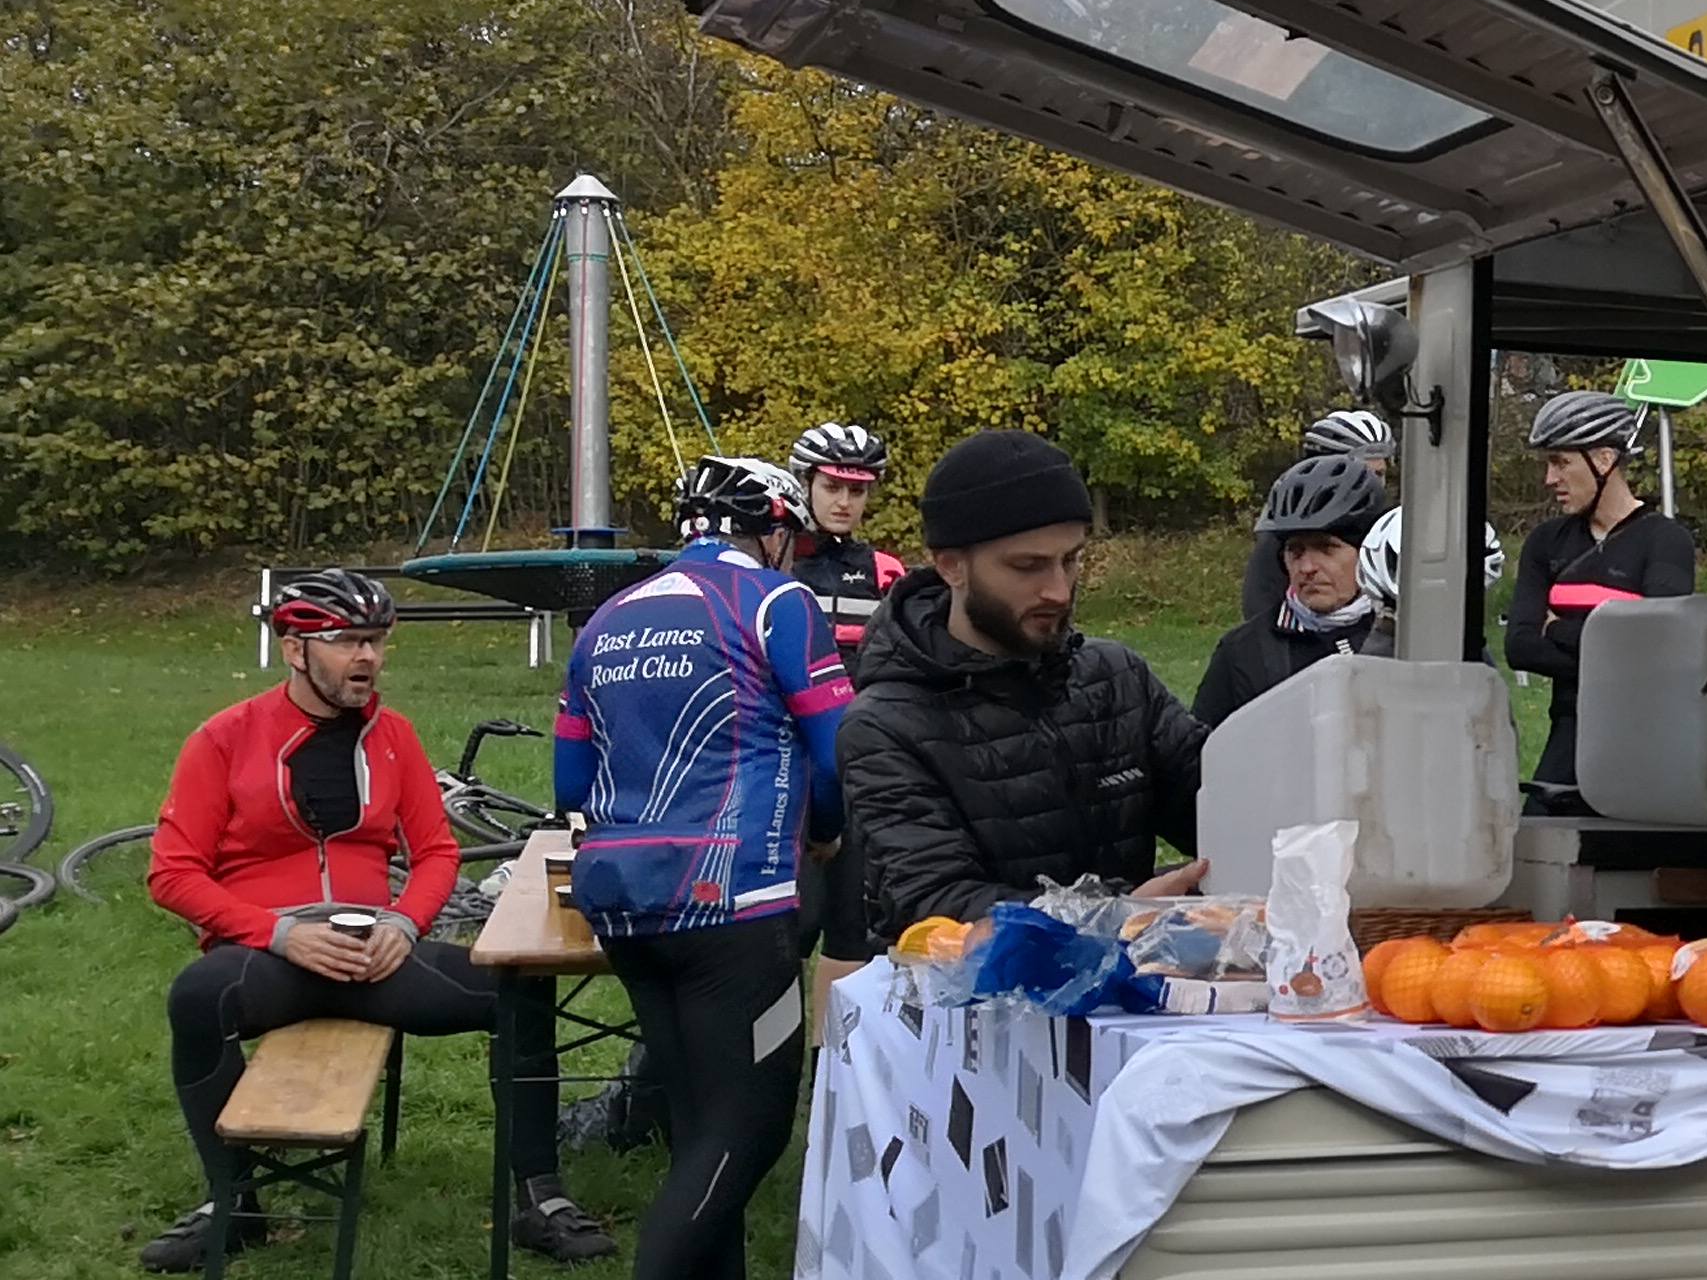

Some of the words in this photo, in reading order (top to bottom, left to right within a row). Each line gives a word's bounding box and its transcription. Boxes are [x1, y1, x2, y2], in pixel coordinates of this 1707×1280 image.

[591, 629, 637, 657] East
[638, 627, 704, 649] Lancs
[591, 656, 639, 689] Road
[642, 654, 693, 679] Club
[774, 746, 792, 790] Road
[766, 792, 789, 838] Lancs
